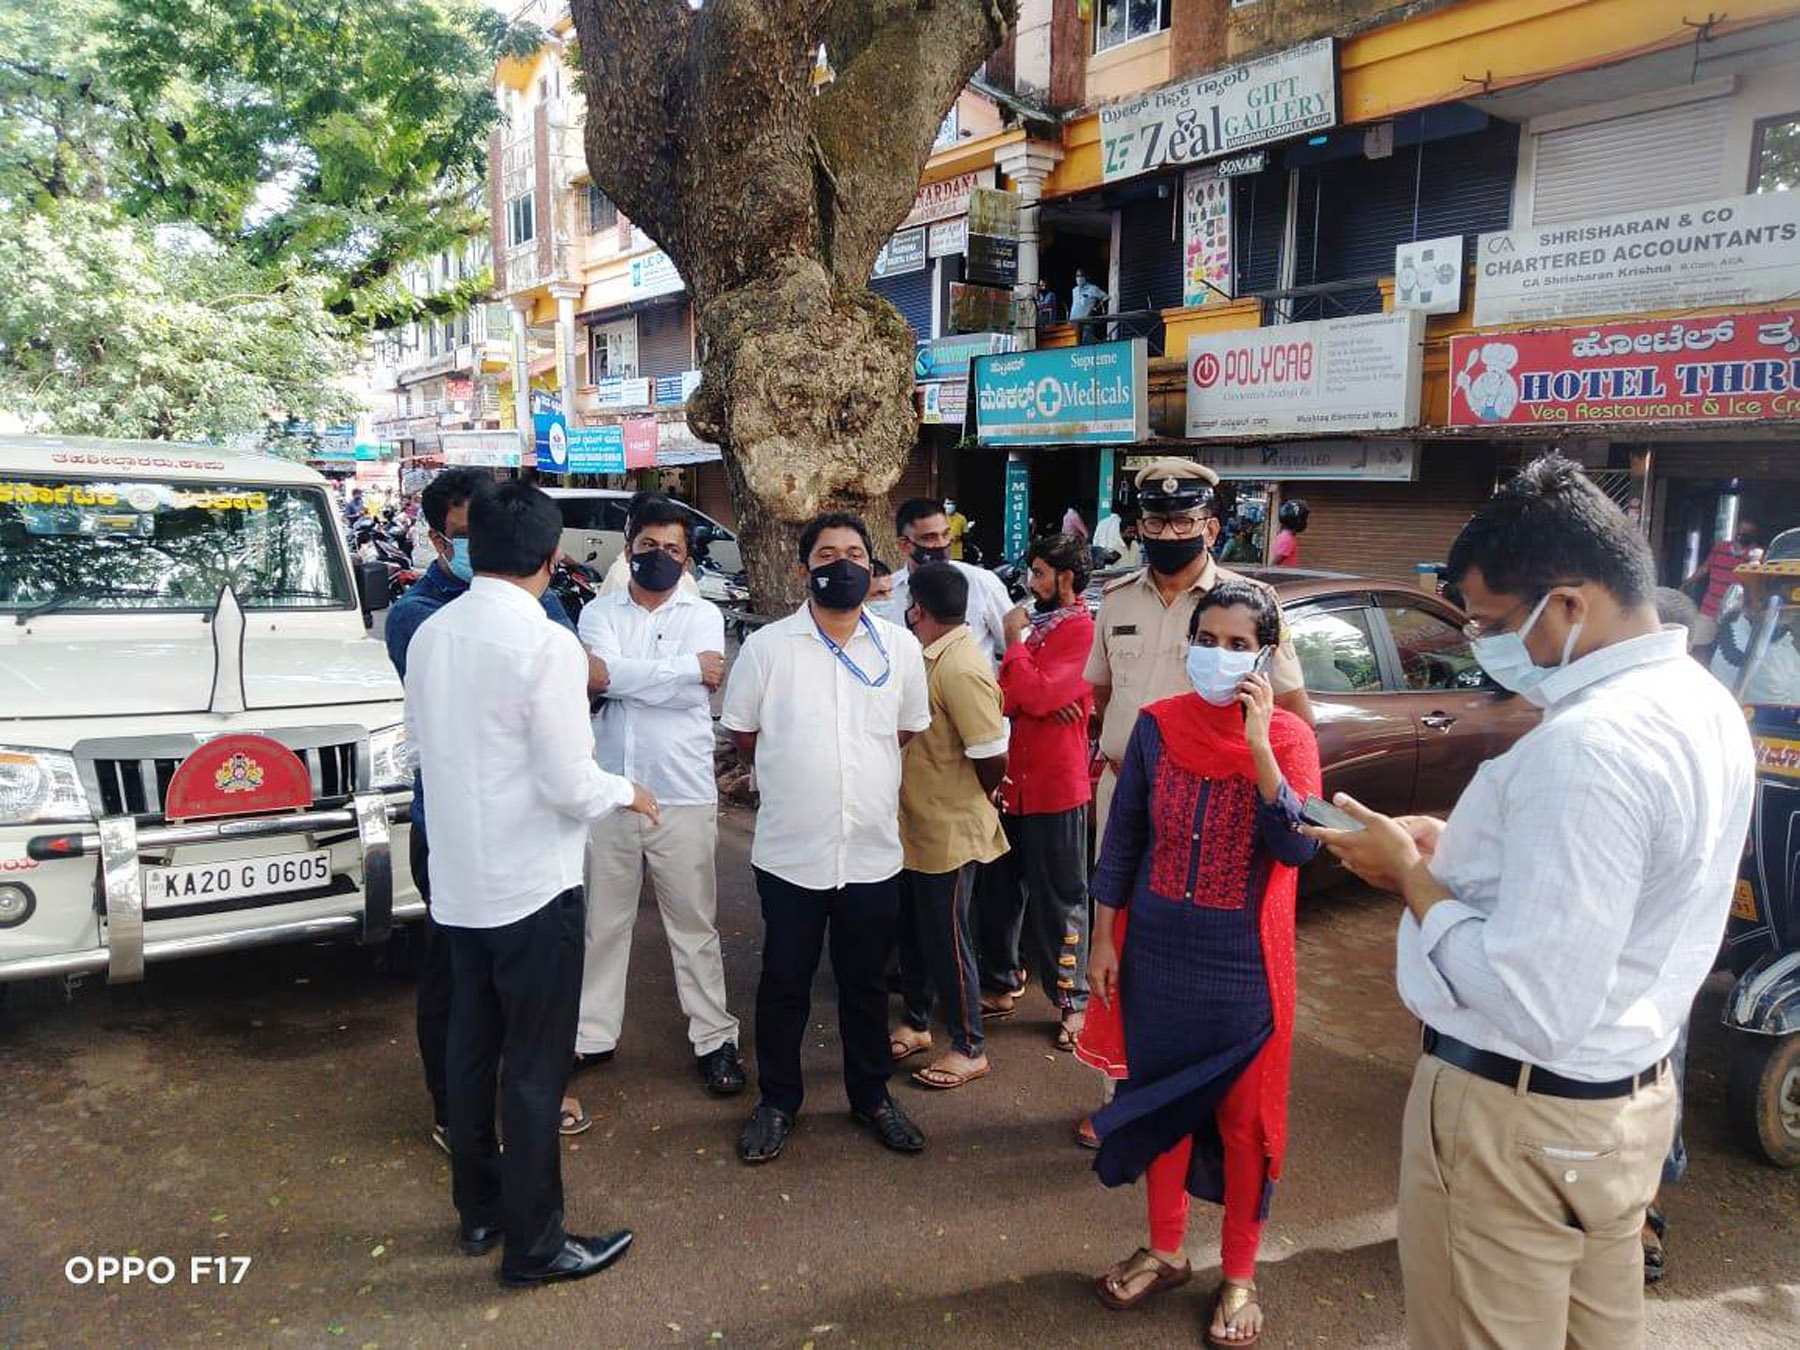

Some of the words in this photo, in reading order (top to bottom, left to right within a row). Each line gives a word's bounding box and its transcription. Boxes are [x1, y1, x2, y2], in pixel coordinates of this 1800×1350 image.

[1247, 76, 1299, 108] GIFT
[1224, 92, 1329, 137] GALLERY
[1140, 106, 1225, 171] Zeal
[1539, 216, 1671, 248] SHRISHARAN
[1677, 213, 1693, 227] &
[1702, 207, 1734, 225] CO
[1484, 248, 1606, 277] CHARTERED
[1612, 222, 1798, 264] ACCOUNTANTS
[1521, 278, 1541, 289] CA
[1543, 269, 1615, 286] Shrisharan
[1618, 263, 1672, 279] Krishna
[1571, 320, 1734, 359] ಹೋಟೆಲ್
[1070, 351, 1118, 371] Supreme
[1224, 341, 1314, 387] POLYCAB
[1063, 375, 1130, 408] Medicals
[1520, 367, 1666, 403] HOTEL
[1332, 411, 1370, 422] Electrical
[1372, 409, 1399, 420] Works
[1530, 403, 1569, 422] Veg
[1575, 399, 1695, 420] Restaurant
[1701, 398, 1720, 416] &
[1728, 398, 1762, 415] Ice
[165, 868, 231, 898] KA20
[241, 866, 255, 888] G
[267, 857, 328, 885] 0605
